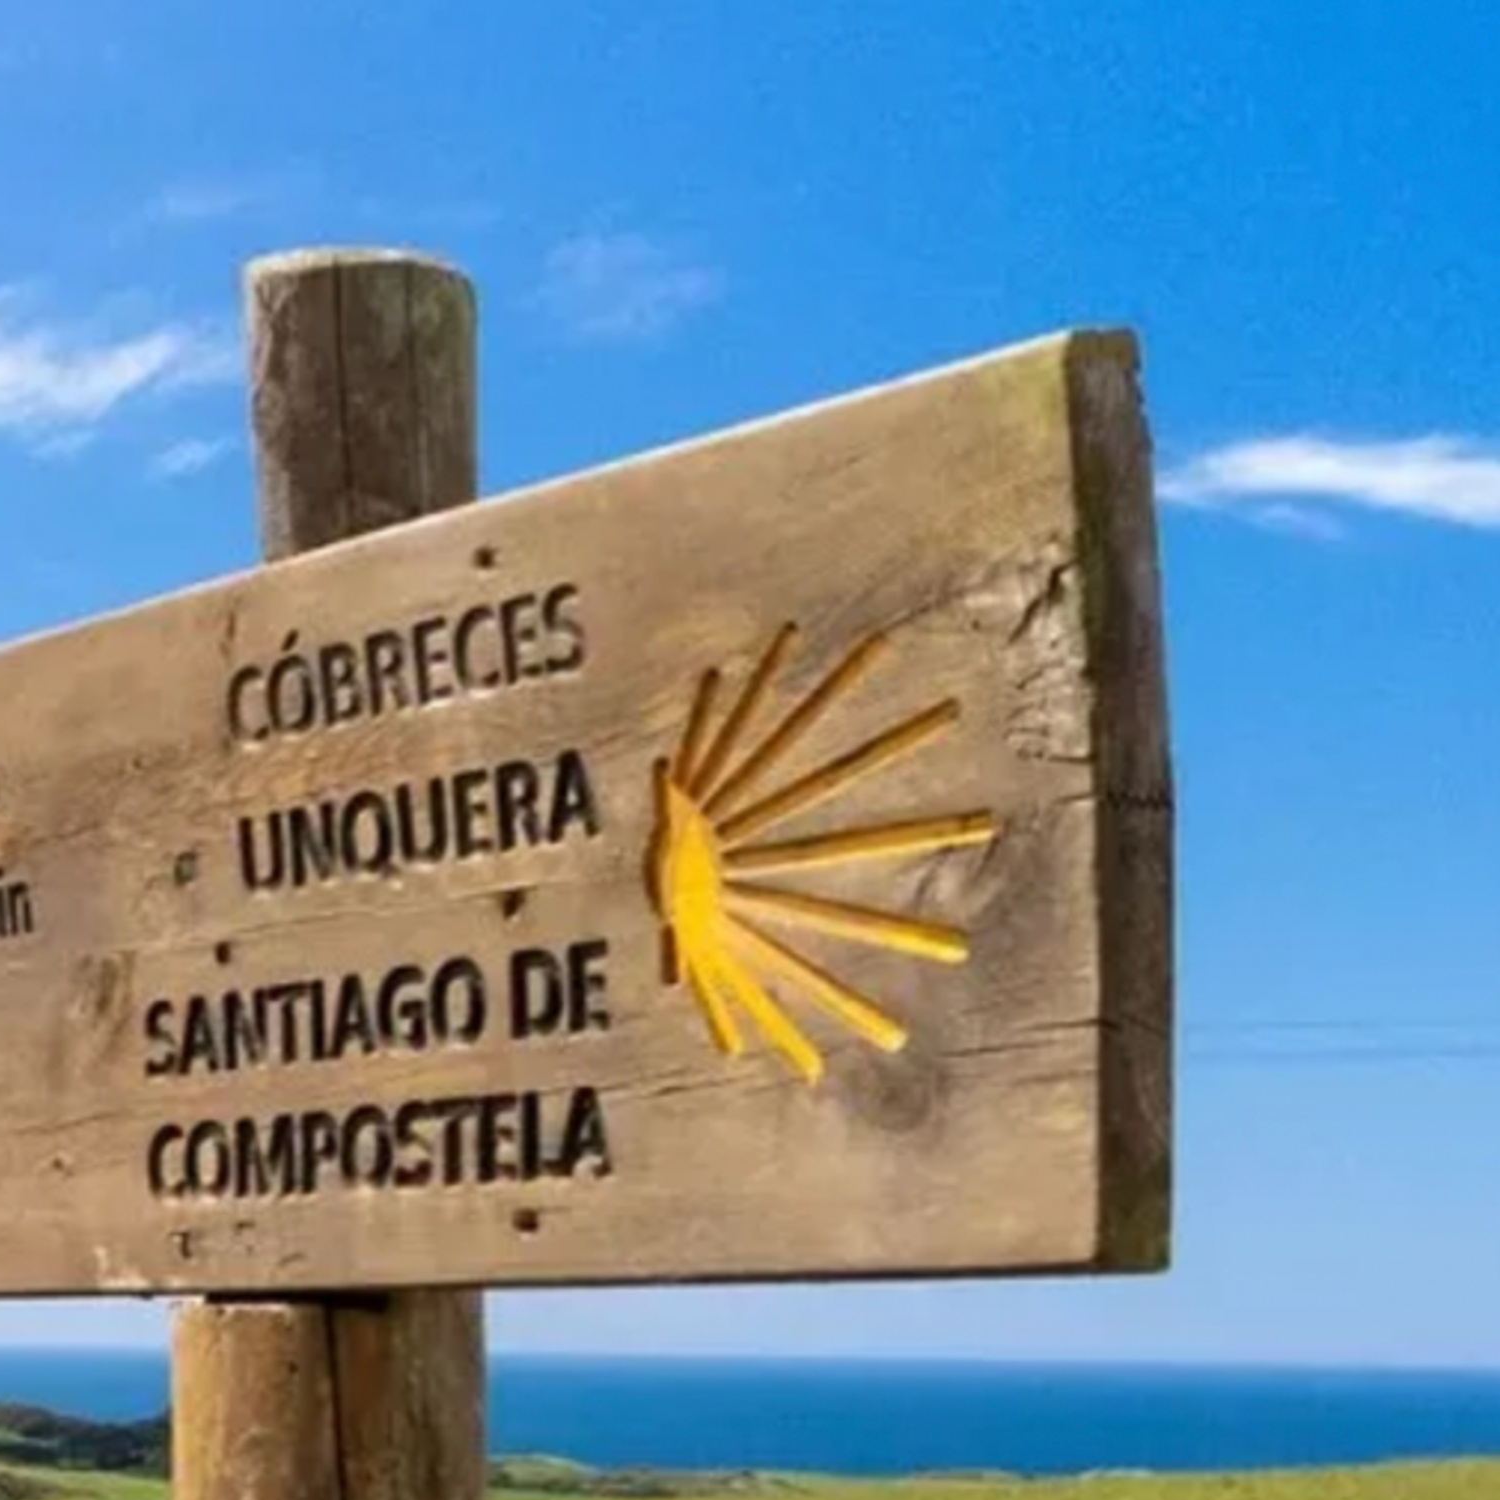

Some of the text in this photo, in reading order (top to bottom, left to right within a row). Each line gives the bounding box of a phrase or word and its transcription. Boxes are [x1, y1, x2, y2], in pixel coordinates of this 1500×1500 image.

[226, 583, 586, 742] CÓBRECES
[236, 748, 602, 892] UNQUERA
[145, 938, 611, 1077] SANTIAGO DE
[147, 1086, 613, 1198] COMPOSTELA
